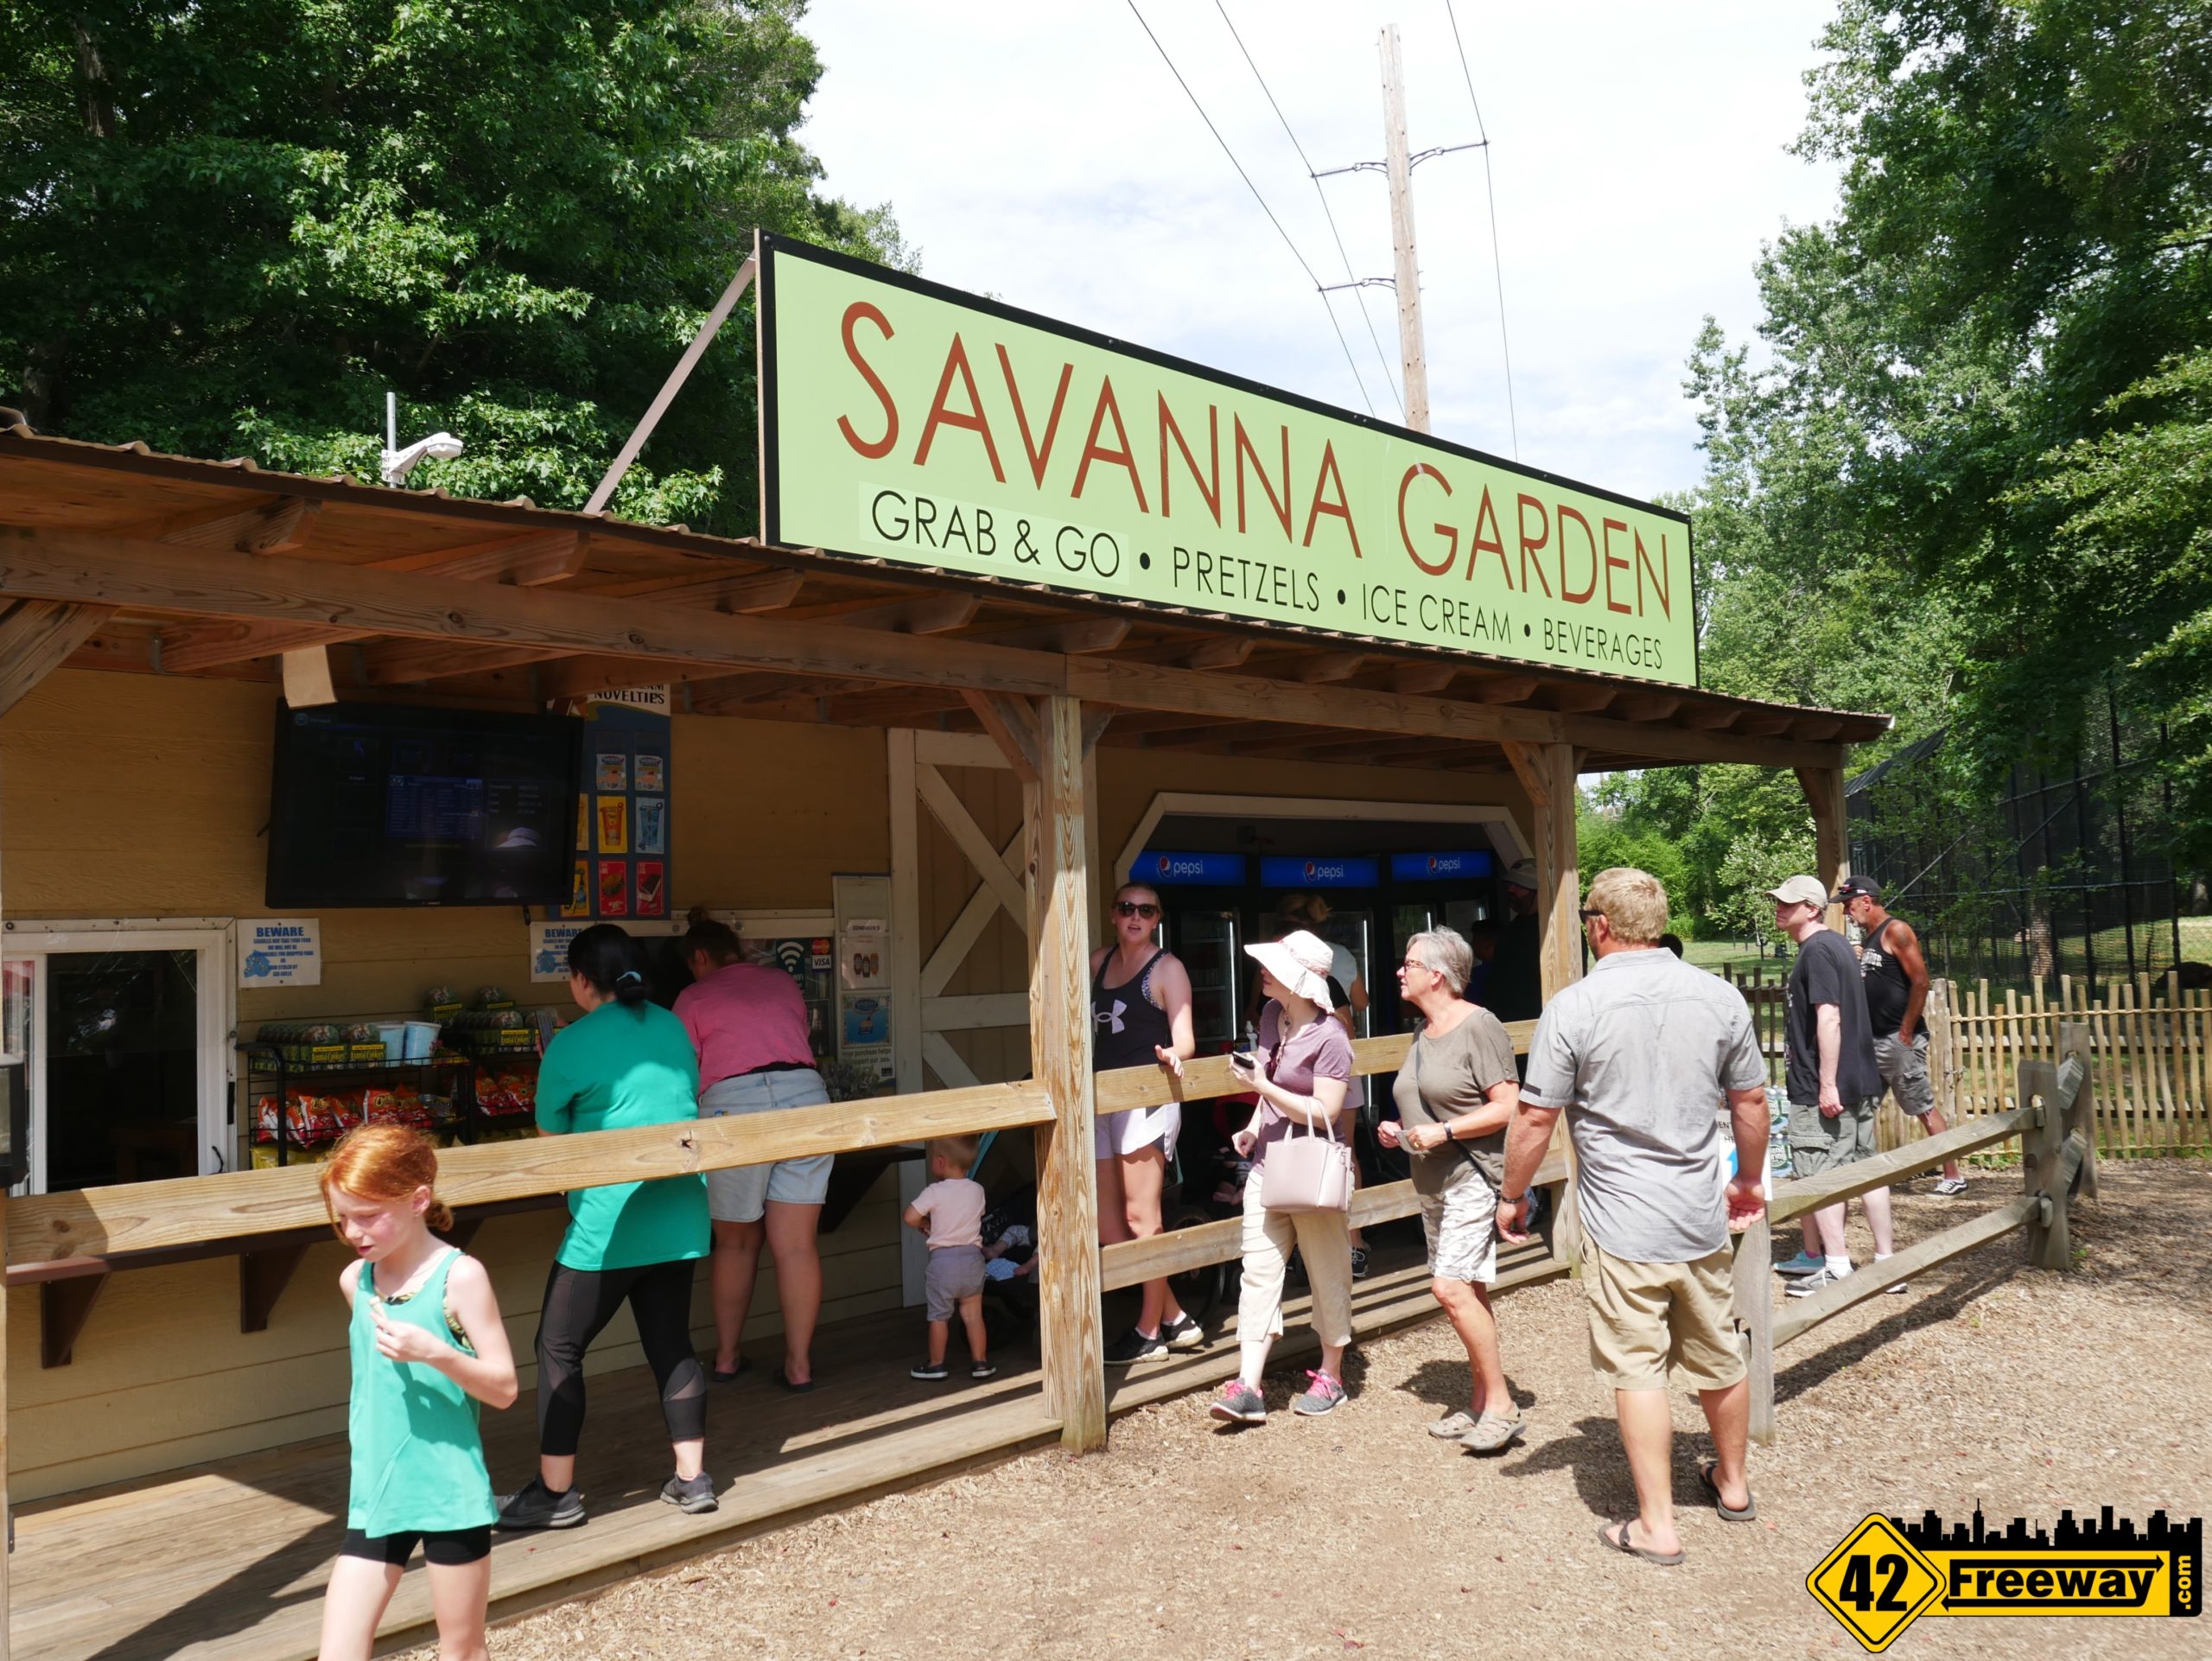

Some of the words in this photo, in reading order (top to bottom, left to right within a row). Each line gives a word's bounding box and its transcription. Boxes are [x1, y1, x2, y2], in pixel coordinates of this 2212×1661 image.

[837, 302, 1363, 557] SAVANNA
[1398, 462, 1672, 621] GARDEN
[872, 490, 996, 556] GRAB
[1014, 519, 1042, 565] &
[1055, 525, 1121, 578] GO
[1173, 546, 1320, 613] PRETZELS
[1363, 583, 1408, 627] ICE
[1419, 594, 1512, 645] CREAM
[1544, 617, 1664, 670] BEVERAGES
[594, 690, 664, 704] NOVELTIES
[1173, 859, 1203, 877] pepsi
[1318, 864, 1344, 881] pepsi
[1439, 856, 1460, 872] pepsi
[256, 926, 304, 937] BEWARE
